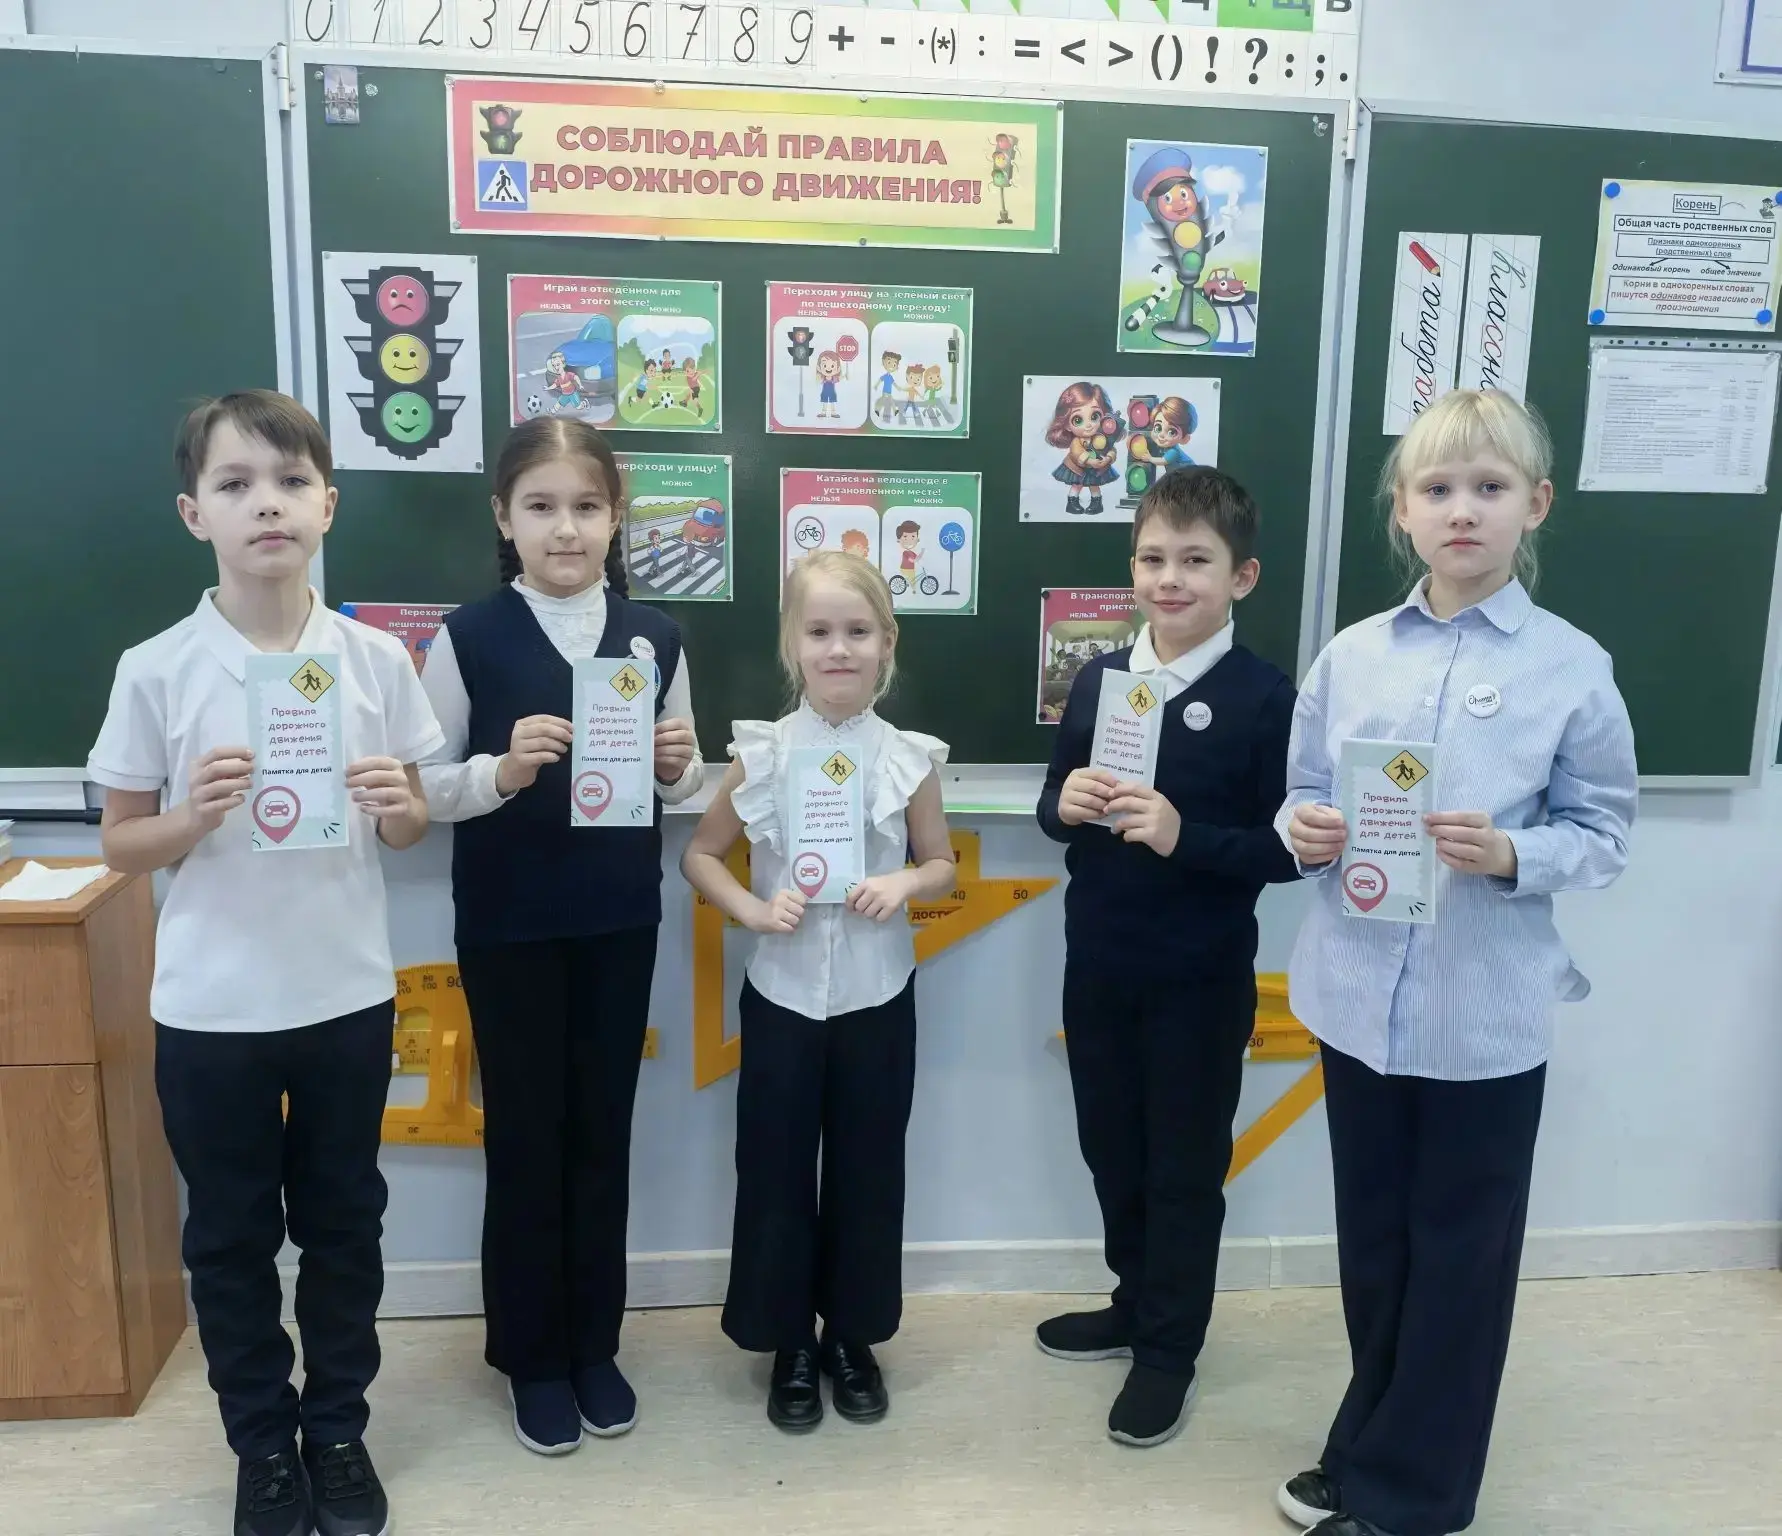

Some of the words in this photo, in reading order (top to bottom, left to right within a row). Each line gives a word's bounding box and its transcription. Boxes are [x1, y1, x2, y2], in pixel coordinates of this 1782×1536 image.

[469, 0, 497, 49] 3
[569, 0, 600, 54] 5
[623, 1, 650, 57] 6
[679, 3, 706, 59] 7
[733, 6, 759, 63] 8
[785, 9, 814, 65] 9
[556, 124, 768, 160] СОБЛЮДАЙ
[778, 134, 947, 166] ПРАВИЛА
[530, 163, 764, 197] ДОРОЖНОГО
[773, 172, 982, 204] ДВИЖЕНИЯ!
[1675, 198, 1717, 211] Корень
[1618, 218, 1651, 228] Общая
[1654, 221, 1681, 229] часть
[1683, 221, 1747, 232] родственных
[1749, 225, 1772, 233] слов
[1648, 238, 1684, 247] Признаки
[1686, 240, 1741, 250] однокоренных
[1612, 264, 1661, 272] Одинаковый
[1663, 266, 1690, 274] корень
[544, 283, 578, 293] Играй
[661, 288, 681, 296] для
[1624, 280, 1651, 289] Корни
[1660, 282, 1723, 292] однокоренных
[784, 287, 838, 297] Переходи
[840, 289, 873, 298] улицу
[580, 298, 610, 306] этого
[1650, 293, 1697, 301] одинаково
[1699, 295, 1748, 303] независимо
[817, 301, 893, 311] пешеходному
[896, 303, 951, 313] переходу!
[1656, 304, 1719, 313] произношения
[615, 463, 674, 472] переходи
[677, 464, 717, 474] улицу!
[816, 474, 859, 483] Катайся
[877, 477, 939, 485] велосипеде
[823, 487, 905, 496] установленном
[272, 708, 316, 717] Правила
[593, 704, 630, 712] Правила
[589, 717, 637, 725] дорожного
[269, 722, 325, 731] дорожного
[270, 735, 322, 744] движения
[271, 749, 290, 758] для
[296, 747, 327, 757] детей
[1363, 792, 1408, 803] Правила
[1360, 806, 1416, 815] дорожного
[1360, 819, 1412, 827] движения
[1384, 832, 1416, 840] детей
[1013, 890, 1028, 900] 50
[1249, 1037, 1263, 1047] 30
